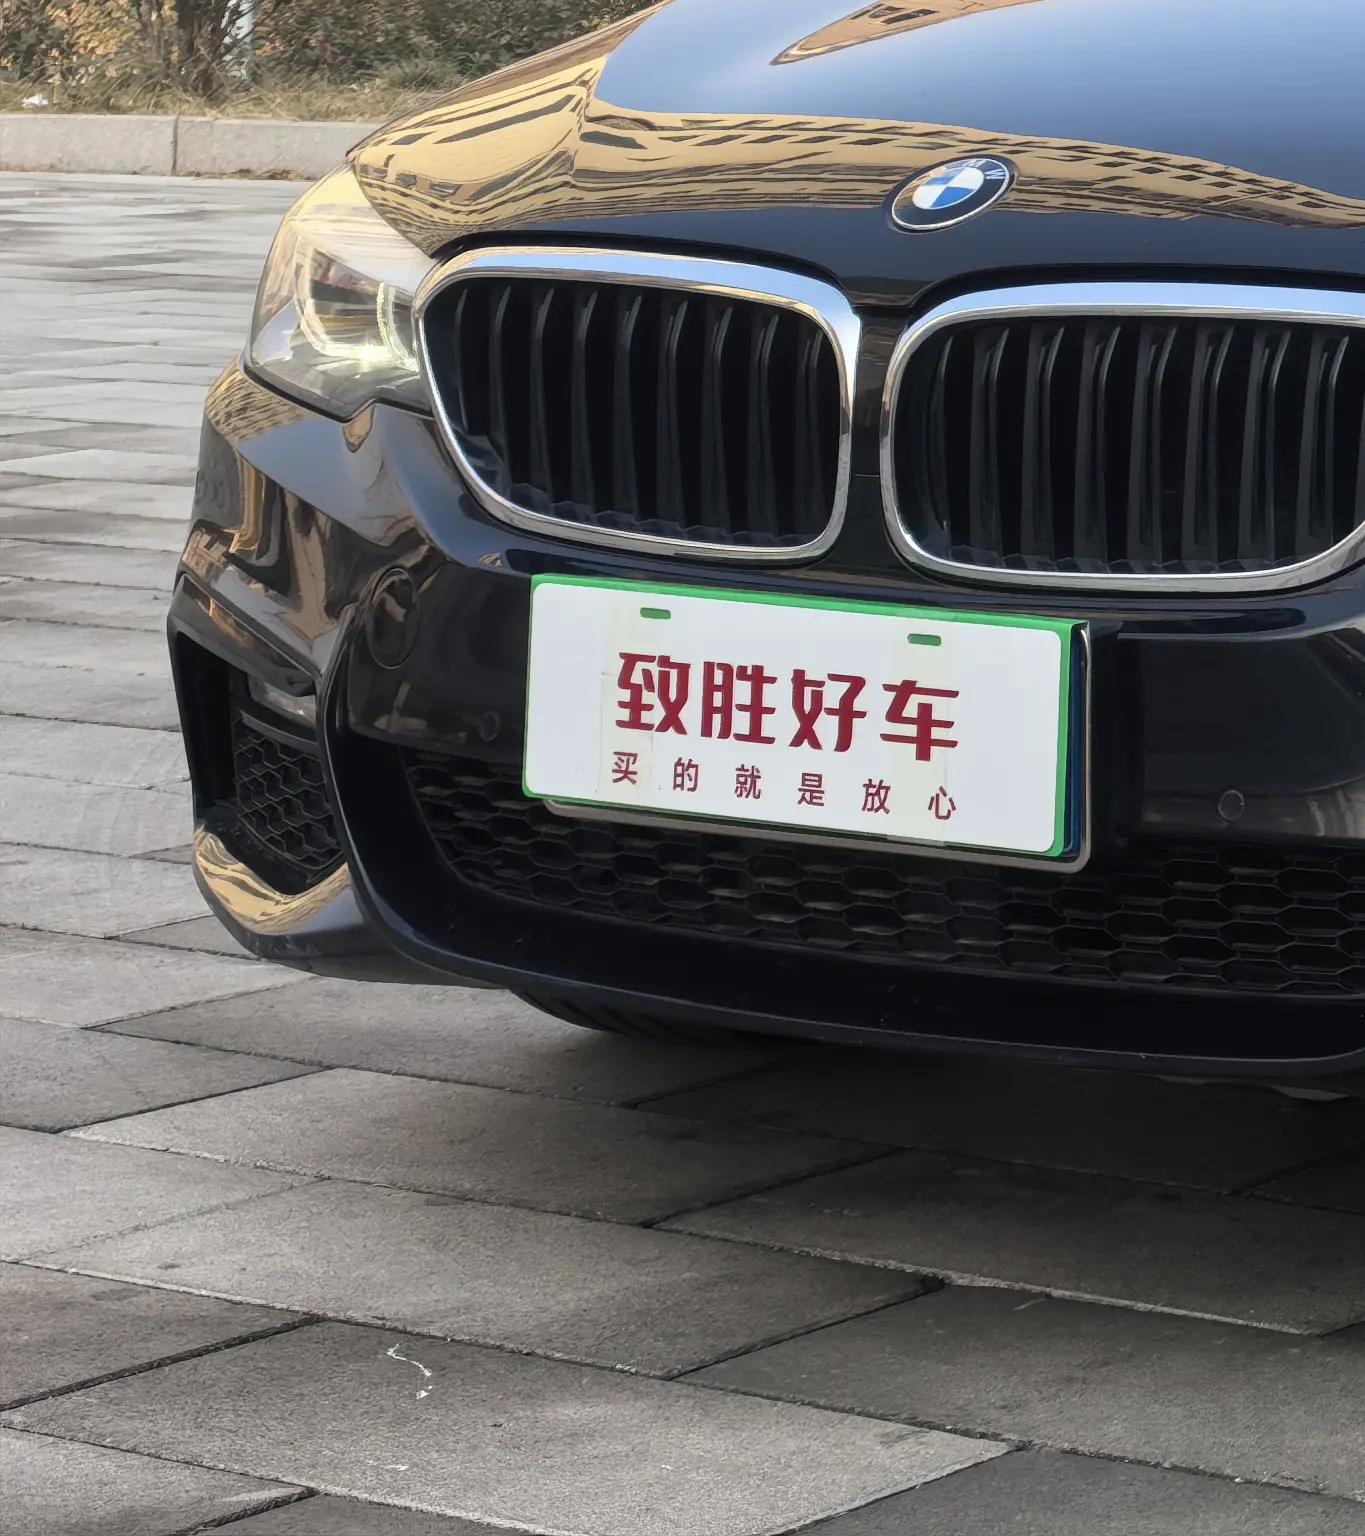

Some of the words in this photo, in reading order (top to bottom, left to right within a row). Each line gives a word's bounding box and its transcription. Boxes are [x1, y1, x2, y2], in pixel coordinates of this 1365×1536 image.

[615, 652, 960, 761] 致胜好车
[611, 751, 956, 820] 买的就是放心
